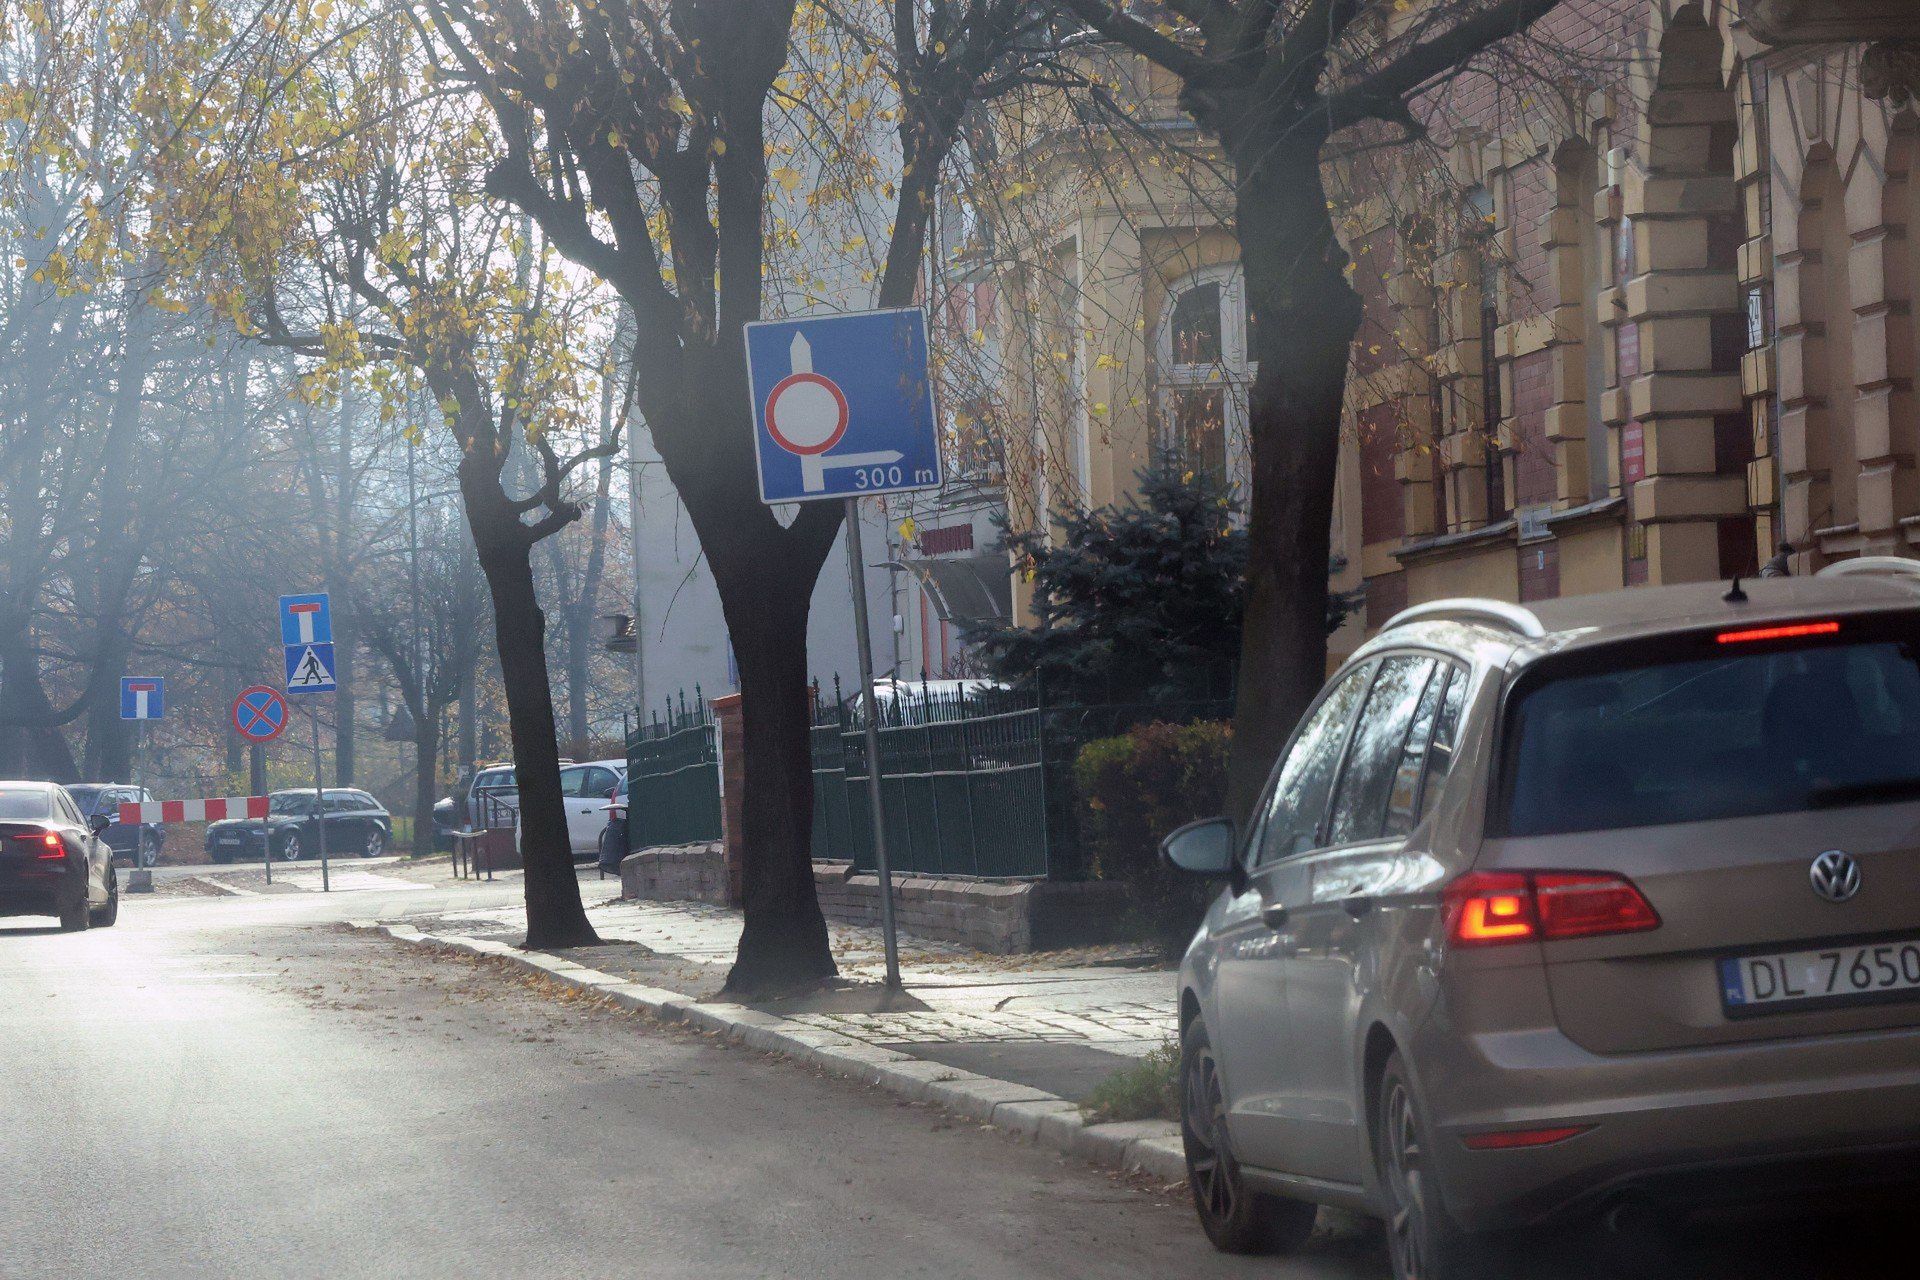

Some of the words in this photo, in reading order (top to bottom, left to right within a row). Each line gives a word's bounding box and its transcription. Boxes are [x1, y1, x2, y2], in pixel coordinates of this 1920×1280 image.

[854, 465, 902, 489] 300
[914, 468, 934, 483] m
[1750, 959, 1805, 999] DL
[1819, 945, 1920, 993] 7650
